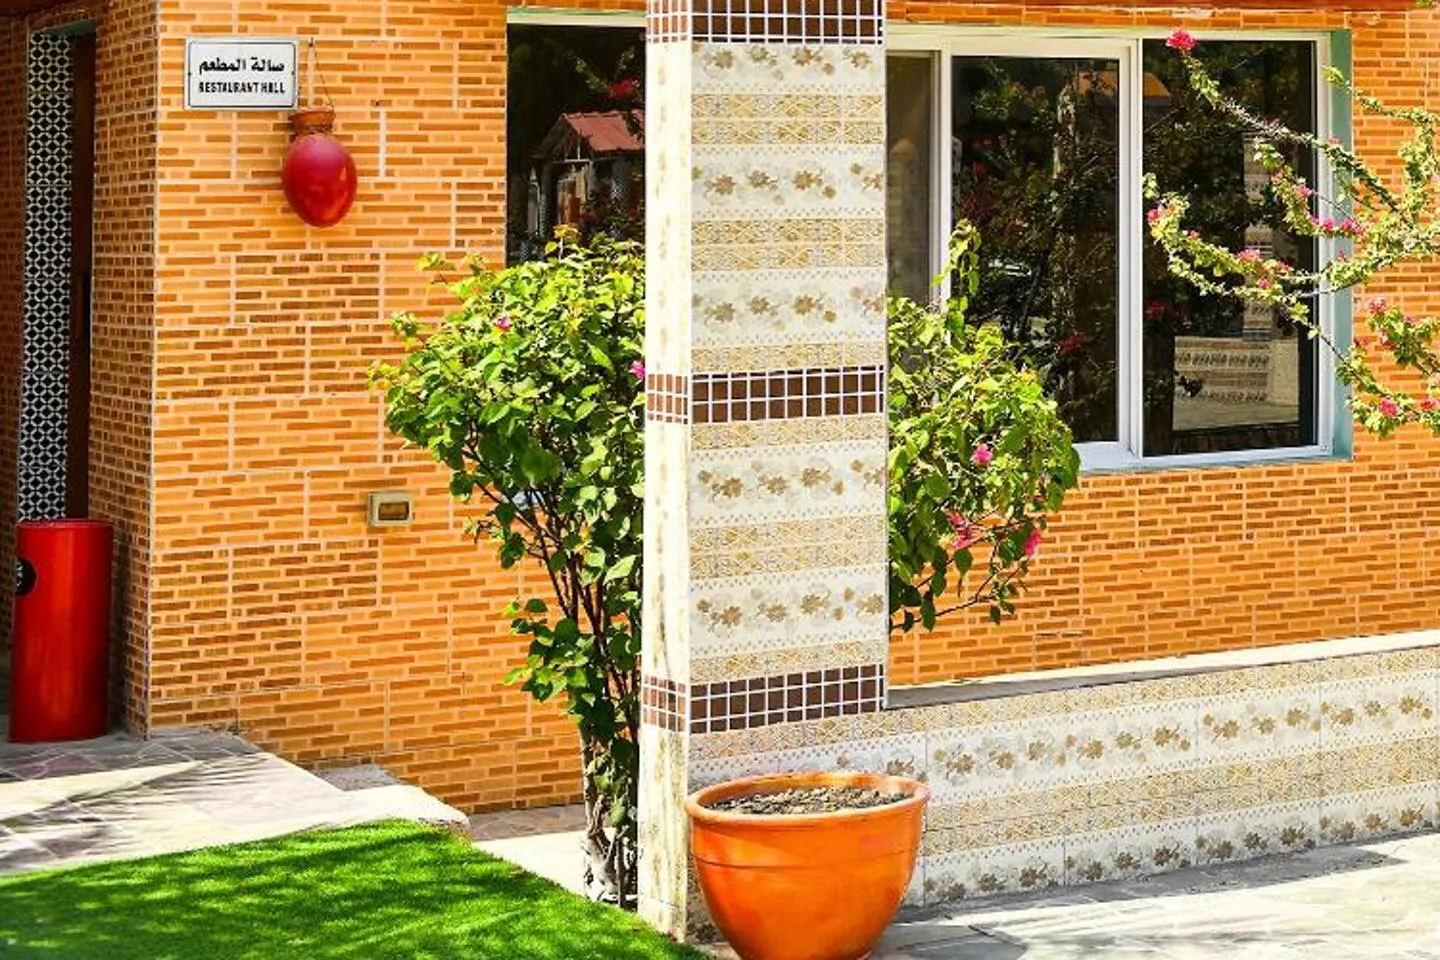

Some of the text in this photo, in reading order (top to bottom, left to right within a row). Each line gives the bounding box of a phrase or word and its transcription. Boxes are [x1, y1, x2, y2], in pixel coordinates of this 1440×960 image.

[199, 56, 285, 75] صالة المطعم
[198, 81, 286, 94] RESTAURANT HALL
